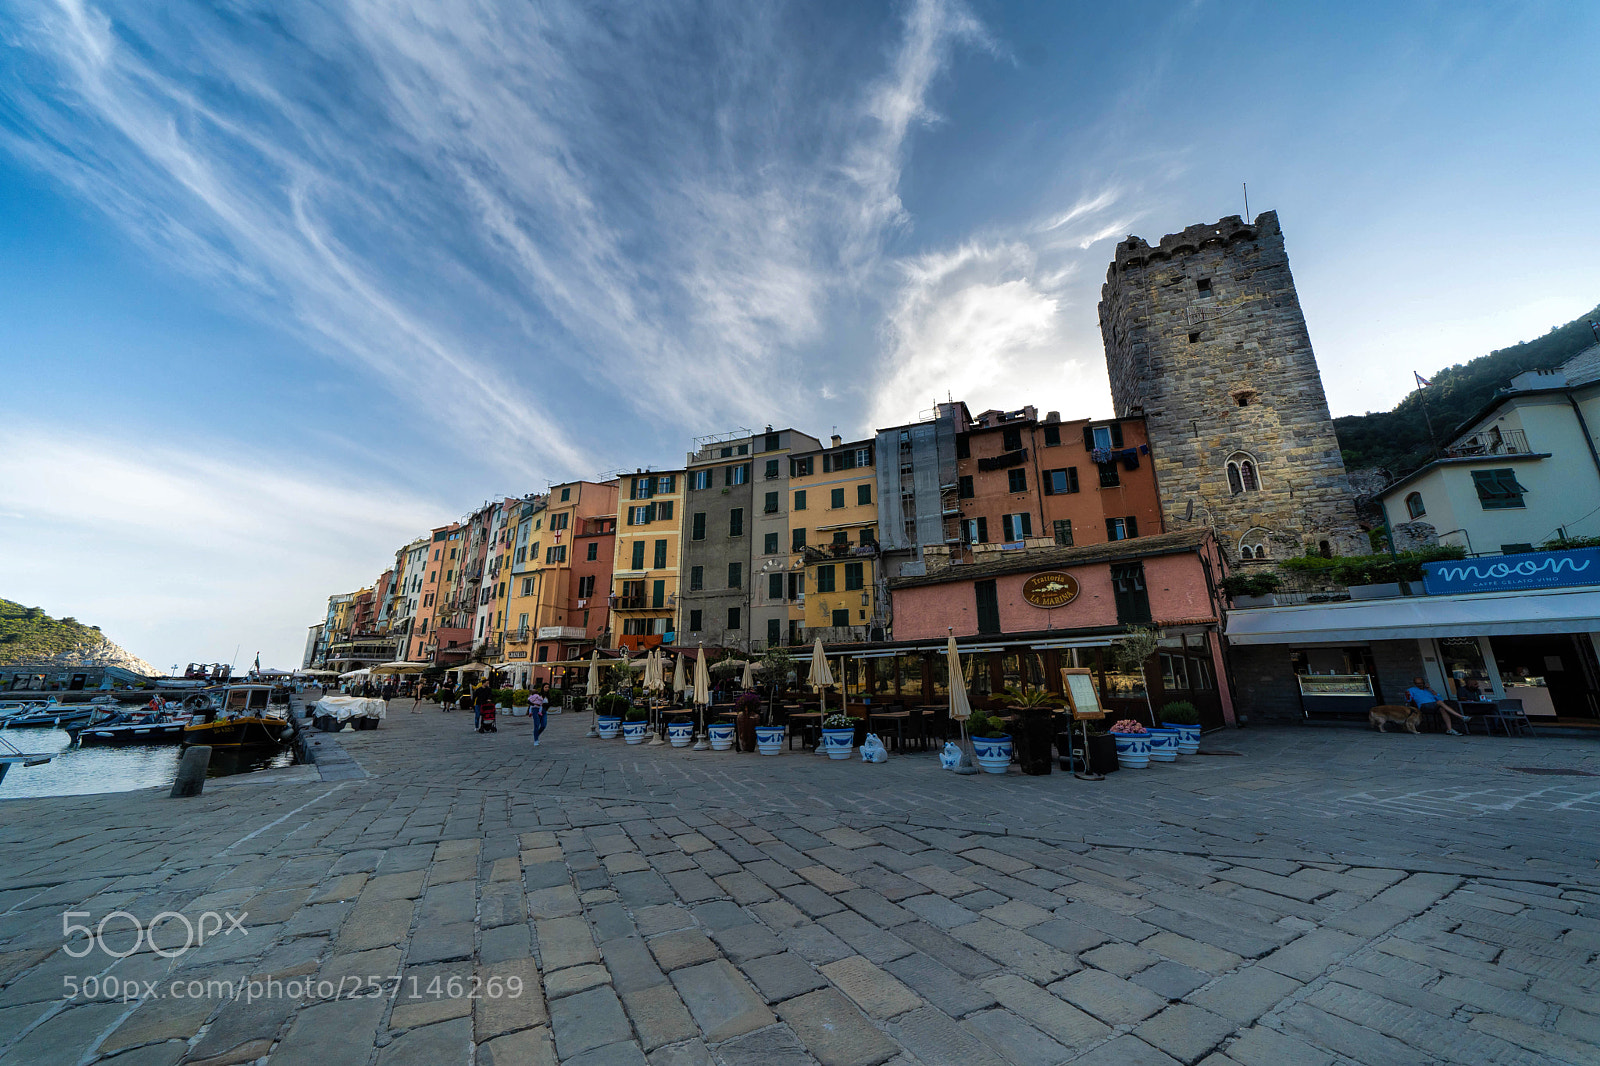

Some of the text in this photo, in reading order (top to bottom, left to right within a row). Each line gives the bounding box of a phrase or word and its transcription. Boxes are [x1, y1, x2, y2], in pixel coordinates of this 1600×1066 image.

[1438, 557, 1590, 582] moon
[1032, 574, 1064, 585] Trattoria
[1030, 591, 1074, 605] LA MARINA
